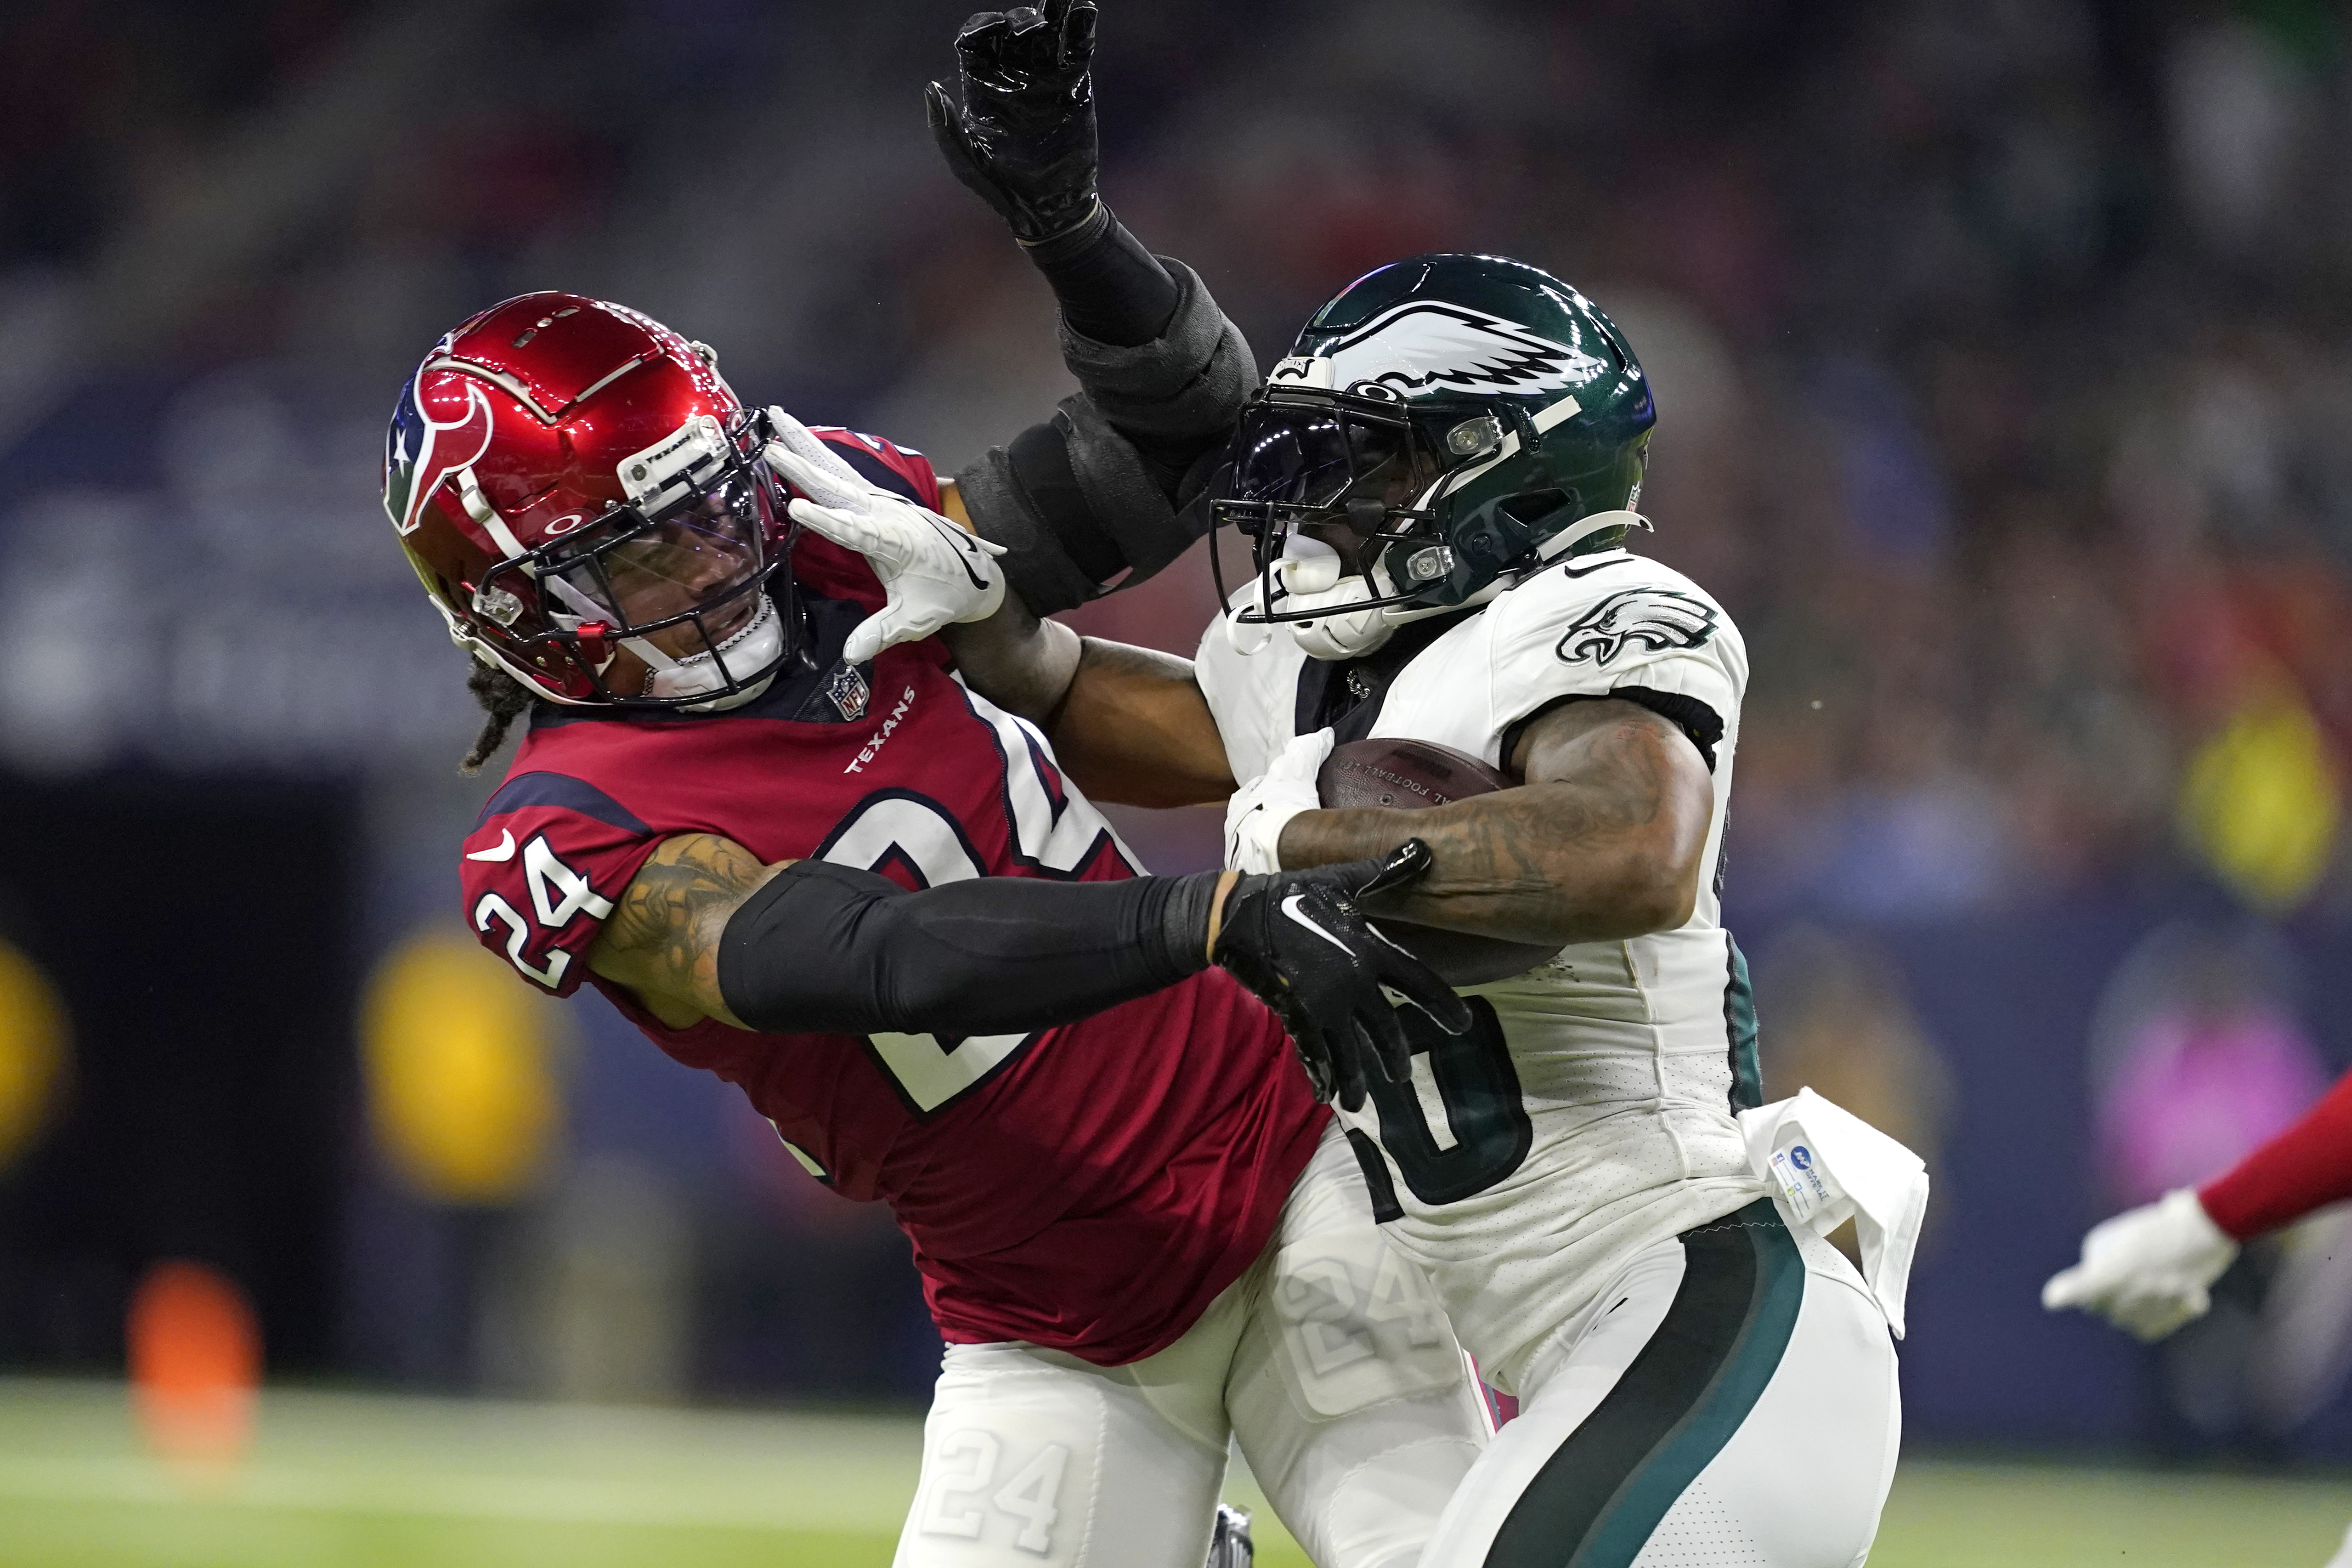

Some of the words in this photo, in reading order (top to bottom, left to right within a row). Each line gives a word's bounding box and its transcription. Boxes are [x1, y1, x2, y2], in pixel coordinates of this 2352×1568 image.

[842, 681, 866, 715] NFL
[843, 685, 915, 774] TEXANS
[1365, 765, 1430, 796] FOOTBALL
[472, 829, 616, 991] 24
[921, 1428, 1069, 1557] 24
